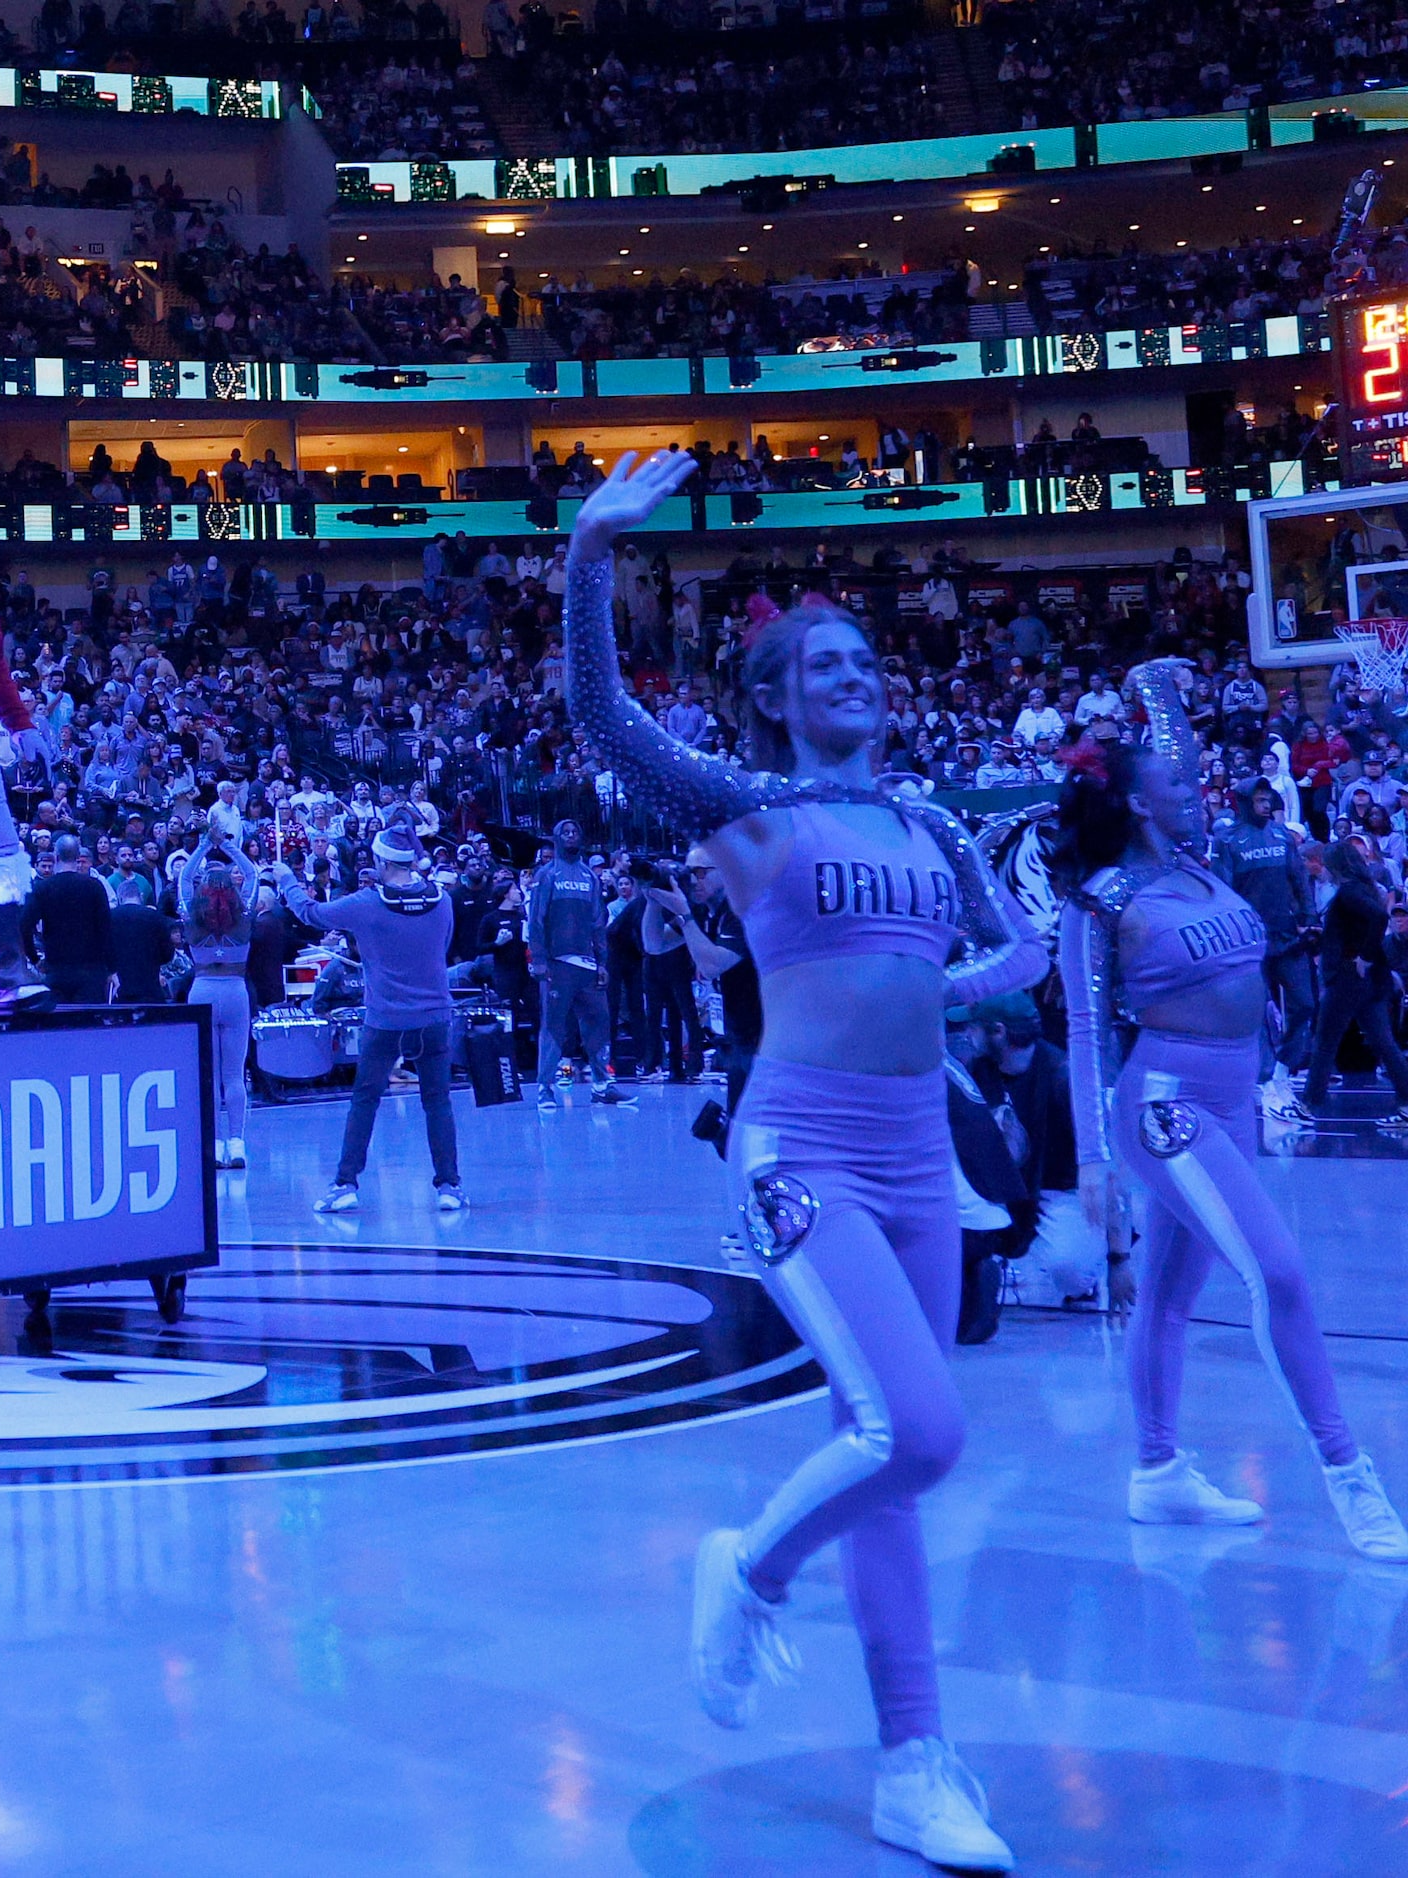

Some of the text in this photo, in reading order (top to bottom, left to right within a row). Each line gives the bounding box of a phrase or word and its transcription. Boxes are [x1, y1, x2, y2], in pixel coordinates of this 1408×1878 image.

[1364, 304, 1408, 344] 12:
[1239, 845, 1286, 862] WOLVES
[553, 880, 591, 892] WOLVES
[815, 862, 961, 926] DALLA
